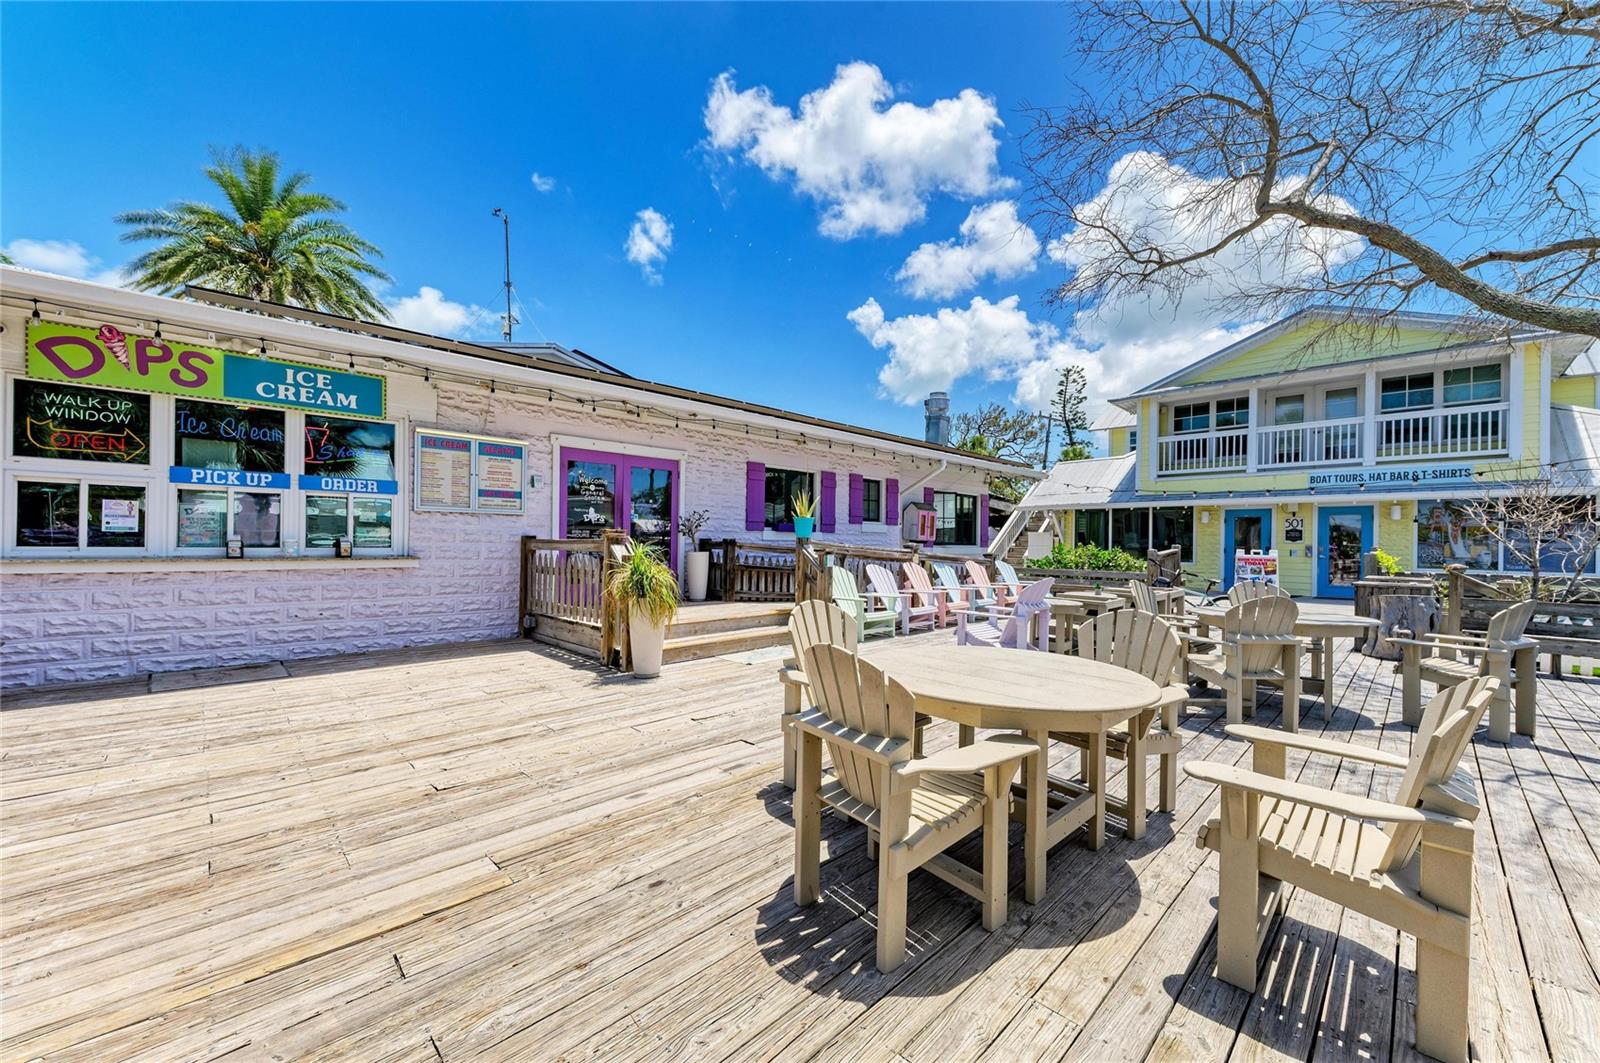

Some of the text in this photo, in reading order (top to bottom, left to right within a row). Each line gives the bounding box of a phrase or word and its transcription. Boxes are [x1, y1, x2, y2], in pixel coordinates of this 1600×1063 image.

[285, 369, 332, 389] ICE
[44, 392, 132, 411] WALK UP
[256, 382, 358, 409] CREAM
[45, 406, 131, 424] WINDOW
[177, 411, 284, 442] Ice Cream
[49, 432, 126, 452] OPEN
[191, 469, 272, 486] PICK UP
[321, 478, 378, 492] ORDER
[1310, 475, 1331, 484] BOAT
[1369, 472, 1386, 481] HAT
[1389, 471, 1409, 481] BAR
[1411, 470, 1420, 481] &
[1421, 468, 1472, 479] T-SHIRTS
[580, 488, 604, 496] General
[1285, 518, 1304, 529] 501
